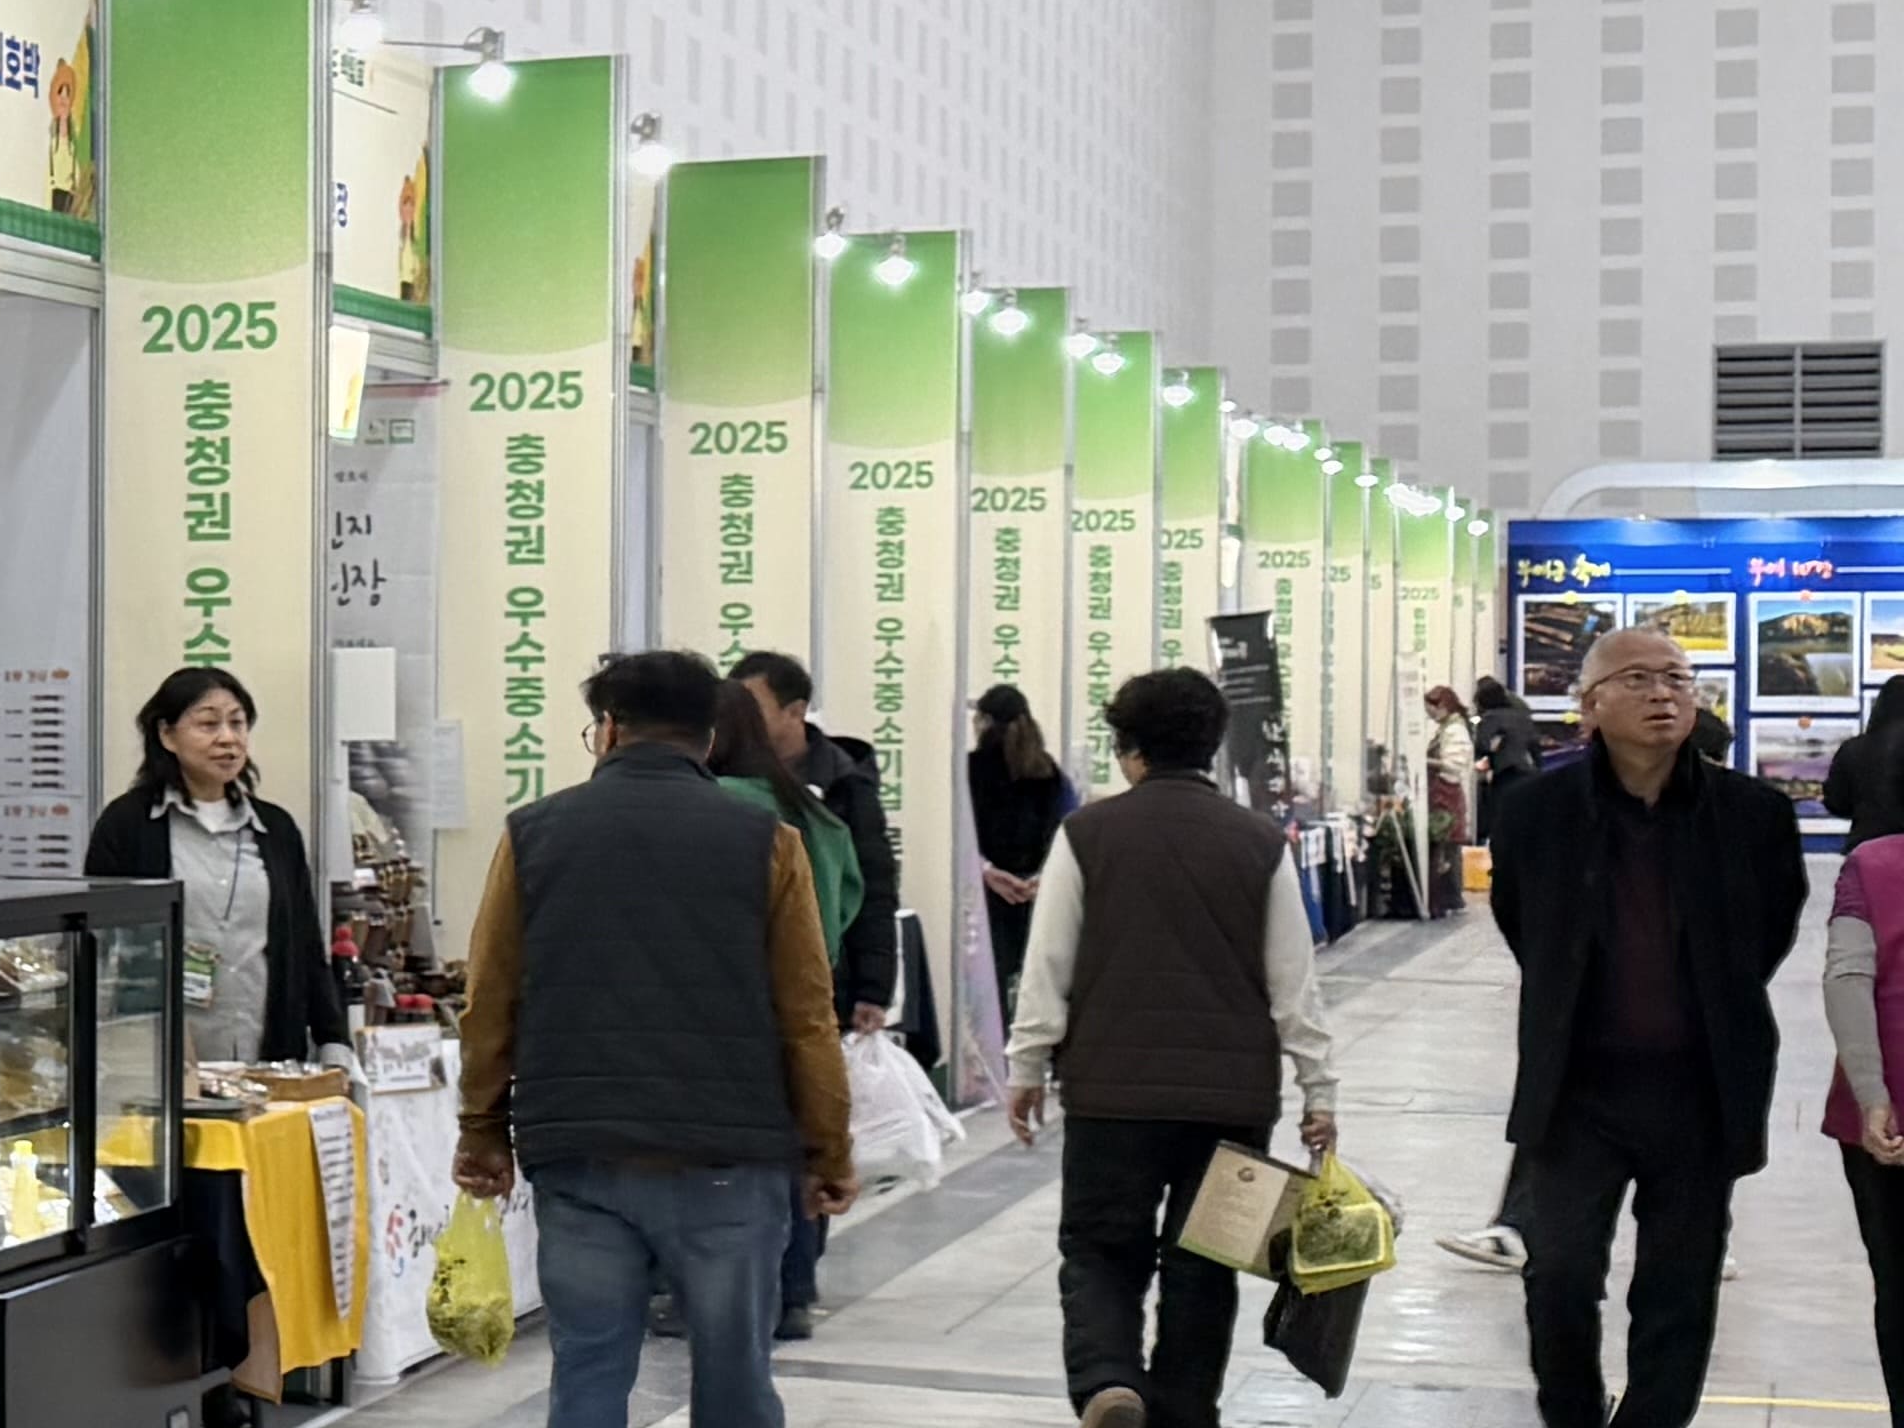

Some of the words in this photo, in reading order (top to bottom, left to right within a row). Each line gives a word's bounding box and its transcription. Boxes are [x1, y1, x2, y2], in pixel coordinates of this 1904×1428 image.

[141, 301, 278, 354] 2025
[469, 371, 583, 414] 2025
[689, 421, 788, 456] 2025
[184, 379, 232, 542] 충청권
[849, 461, 934, 490] 2025
[504, 433, 546, 566] 충청권
[971, 487, 1047, 514] 2025
[719, 473, 754, 585] 충청권
[1071, 510, 1136, 533] 2025
[1160, 530, 1203, 549] 025
[873, 507, 905, 602] 충청권
[1258, 551, 1311, 568] 2025
[504, 586, 546, 805] 우수중소기
